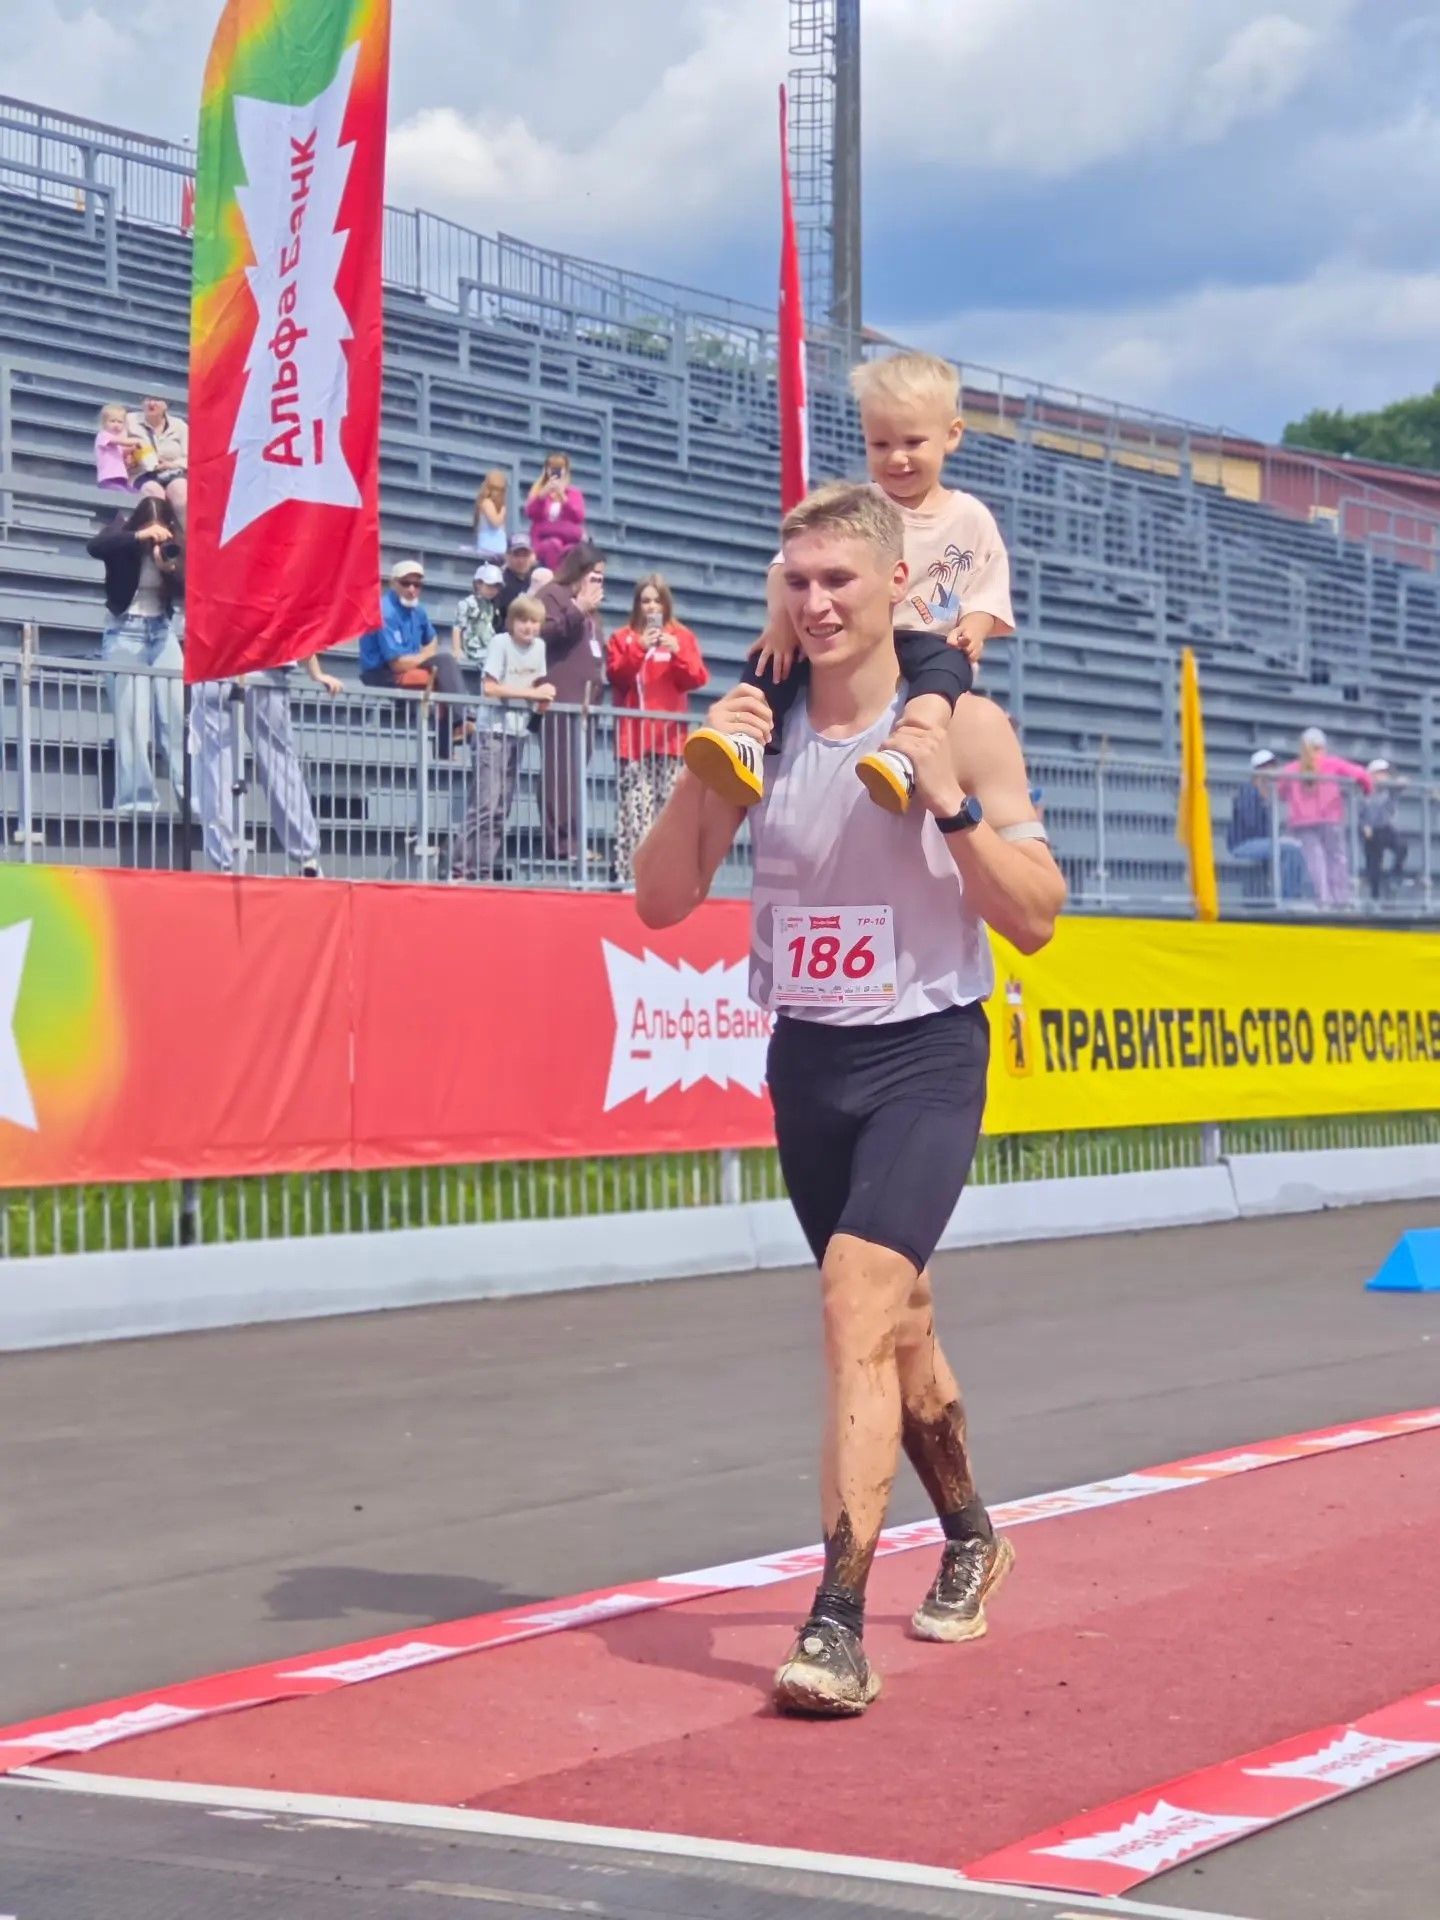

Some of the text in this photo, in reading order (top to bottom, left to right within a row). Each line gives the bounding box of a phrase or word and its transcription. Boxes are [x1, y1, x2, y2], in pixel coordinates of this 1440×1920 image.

[262, 126, 318, 467] Альфа Банк
[788, 935, 875, 979] 186
[631, 998, 712, 1051] Альфа
[1039, 1008, 1440, 1073] ПРАВИТЕЛЬСТВО ЯРОСЛАВ
